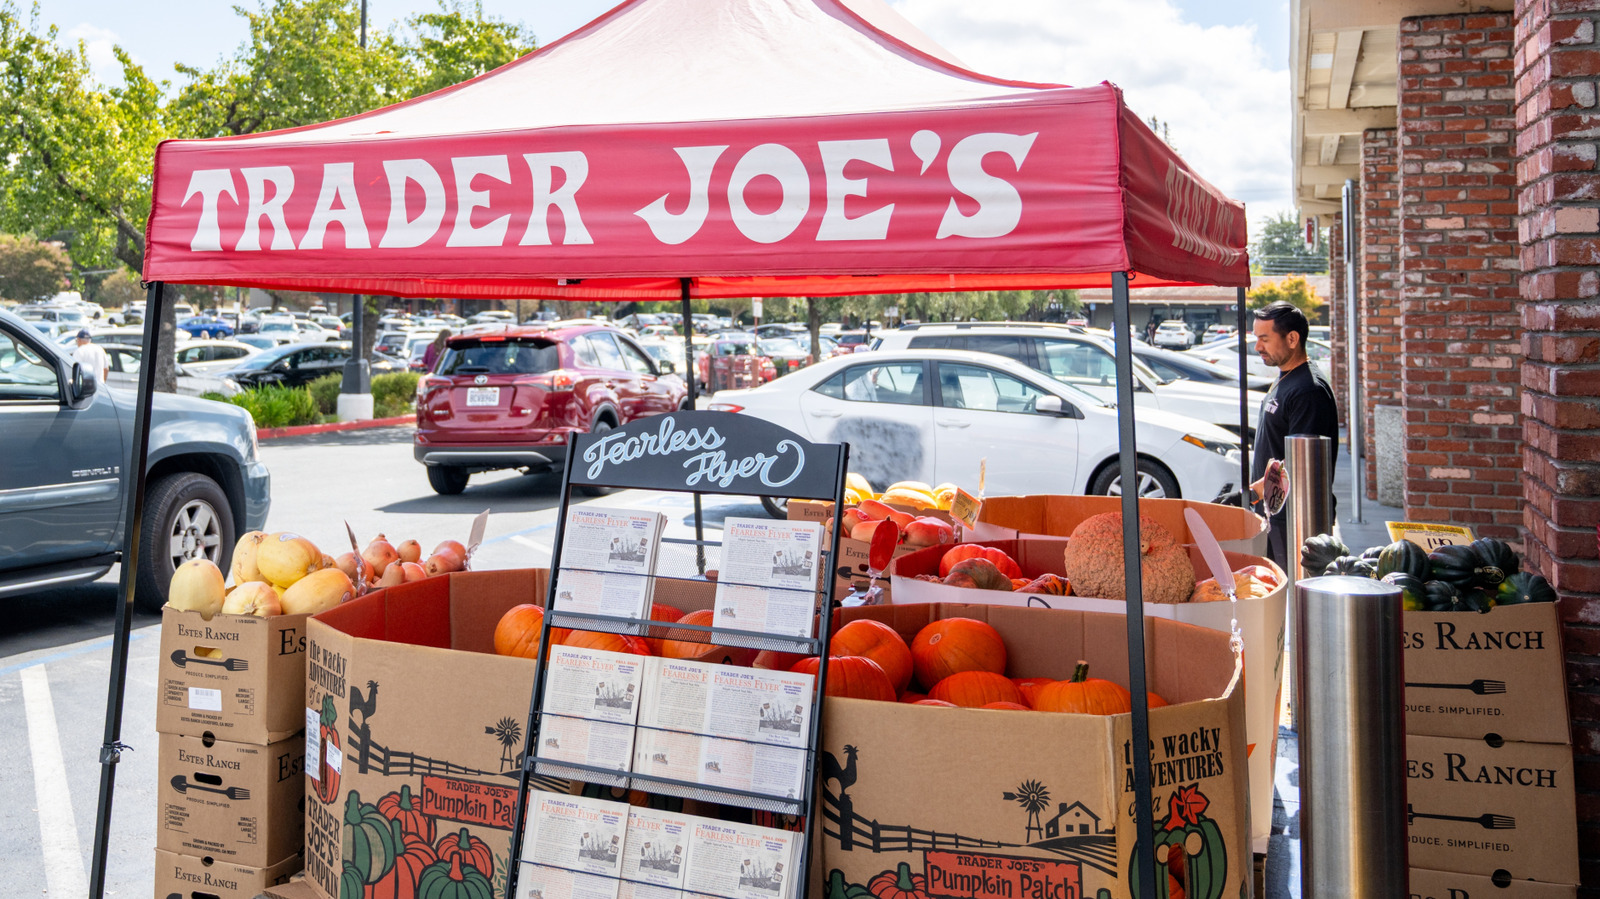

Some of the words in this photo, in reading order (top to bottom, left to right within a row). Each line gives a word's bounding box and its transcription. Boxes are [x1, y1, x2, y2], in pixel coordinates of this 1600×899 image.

[181, 151, 594, 251] TRADER
[633, 129, 1039, 245] JOE'S
[583, 415, 726, 480] Fearless
[72, 467, 111, 478] DENALI
[683, 439, 805, 487] Flyer
[572, 514, 605, 525] FEARLESS
[608, 517, 628, 527] FLYER
[804, 508, 824, 517] ESTES
[730, 527, 766, 536] FEARLESS
[768, 529, 791, 539] FLYER
[178, 624, 203, 637] ESTES
[205, 627, 239, 641] RANCH
[1435, 622, 1545, 650] RANCH
[310, 640, 320, 662] the
[323, 648, 347, 678] wacky
[556, 656, 590, 666] FEARLESS
[592, 660, 614, 671] FLYER
[309, 660, 346, 698] ADVENTURES
[663, 668, 700, 681] FEARLESS
[714, 675, 752, 688] FEARLESS
[754, 680, 779, 692] FLYER
[1404, 705, 1435, 713] DUCE.
[1439, 706, 1505, 716] SIMPLIFIED.
[1162, 726, 1220, 758] wacky
[178, 748, 204, 765] ESTES
[206, 755, 240, 770] RANCH
[1124, 752, 1223, 792] AVENTURES
[1444, 753, 1557, 788] RANCH
[446, 781, 481, 794] TRADER
[425, 788, 486, 820] Pumpkin
[493, 799, 517, 826] Pat
[541, 802, 576, 816] FEARLESS
[578, 809, 598, 821] FLYER
[308, 795, 340, 844] TRADER
[637, 817, 661, 830] FLYER
[695, 827, 734, 842] FEARLESS
[736, 834, 761, 847] FLYER
[1447, 839, 1513, 852] SIMPLIFIED.
[307, 846, 338, 899] PUMPKIN
[957, 856, 1003, 869] TRADER
[175, 866, 201, 882] ESTES
[204, 872, 237, 890] RANCH
[930, 864, 1012, 898] Pumpkin
[1020, 873, 1074, 899] Patch
